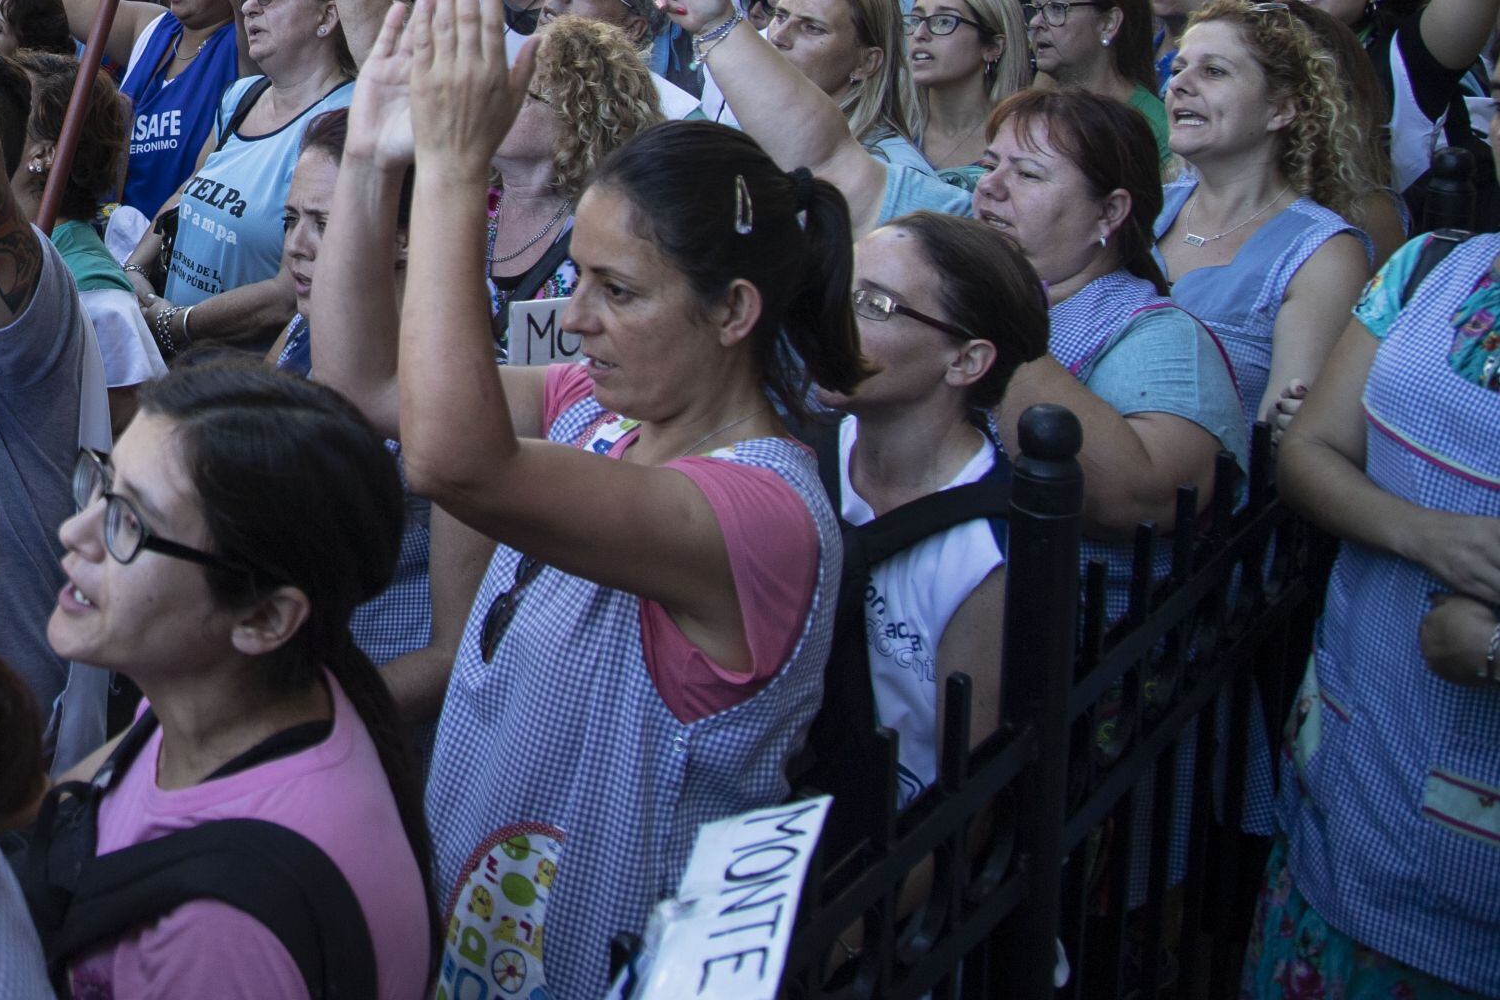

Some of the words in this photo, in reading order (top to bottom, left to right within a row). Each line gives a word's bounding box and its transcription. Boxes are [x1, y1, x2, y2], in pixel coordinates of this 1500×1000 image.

[130, 109, 182, 142] SAFE
[196, 263, 210, 277] DE
[696, 804, 820, 997] MONTE
